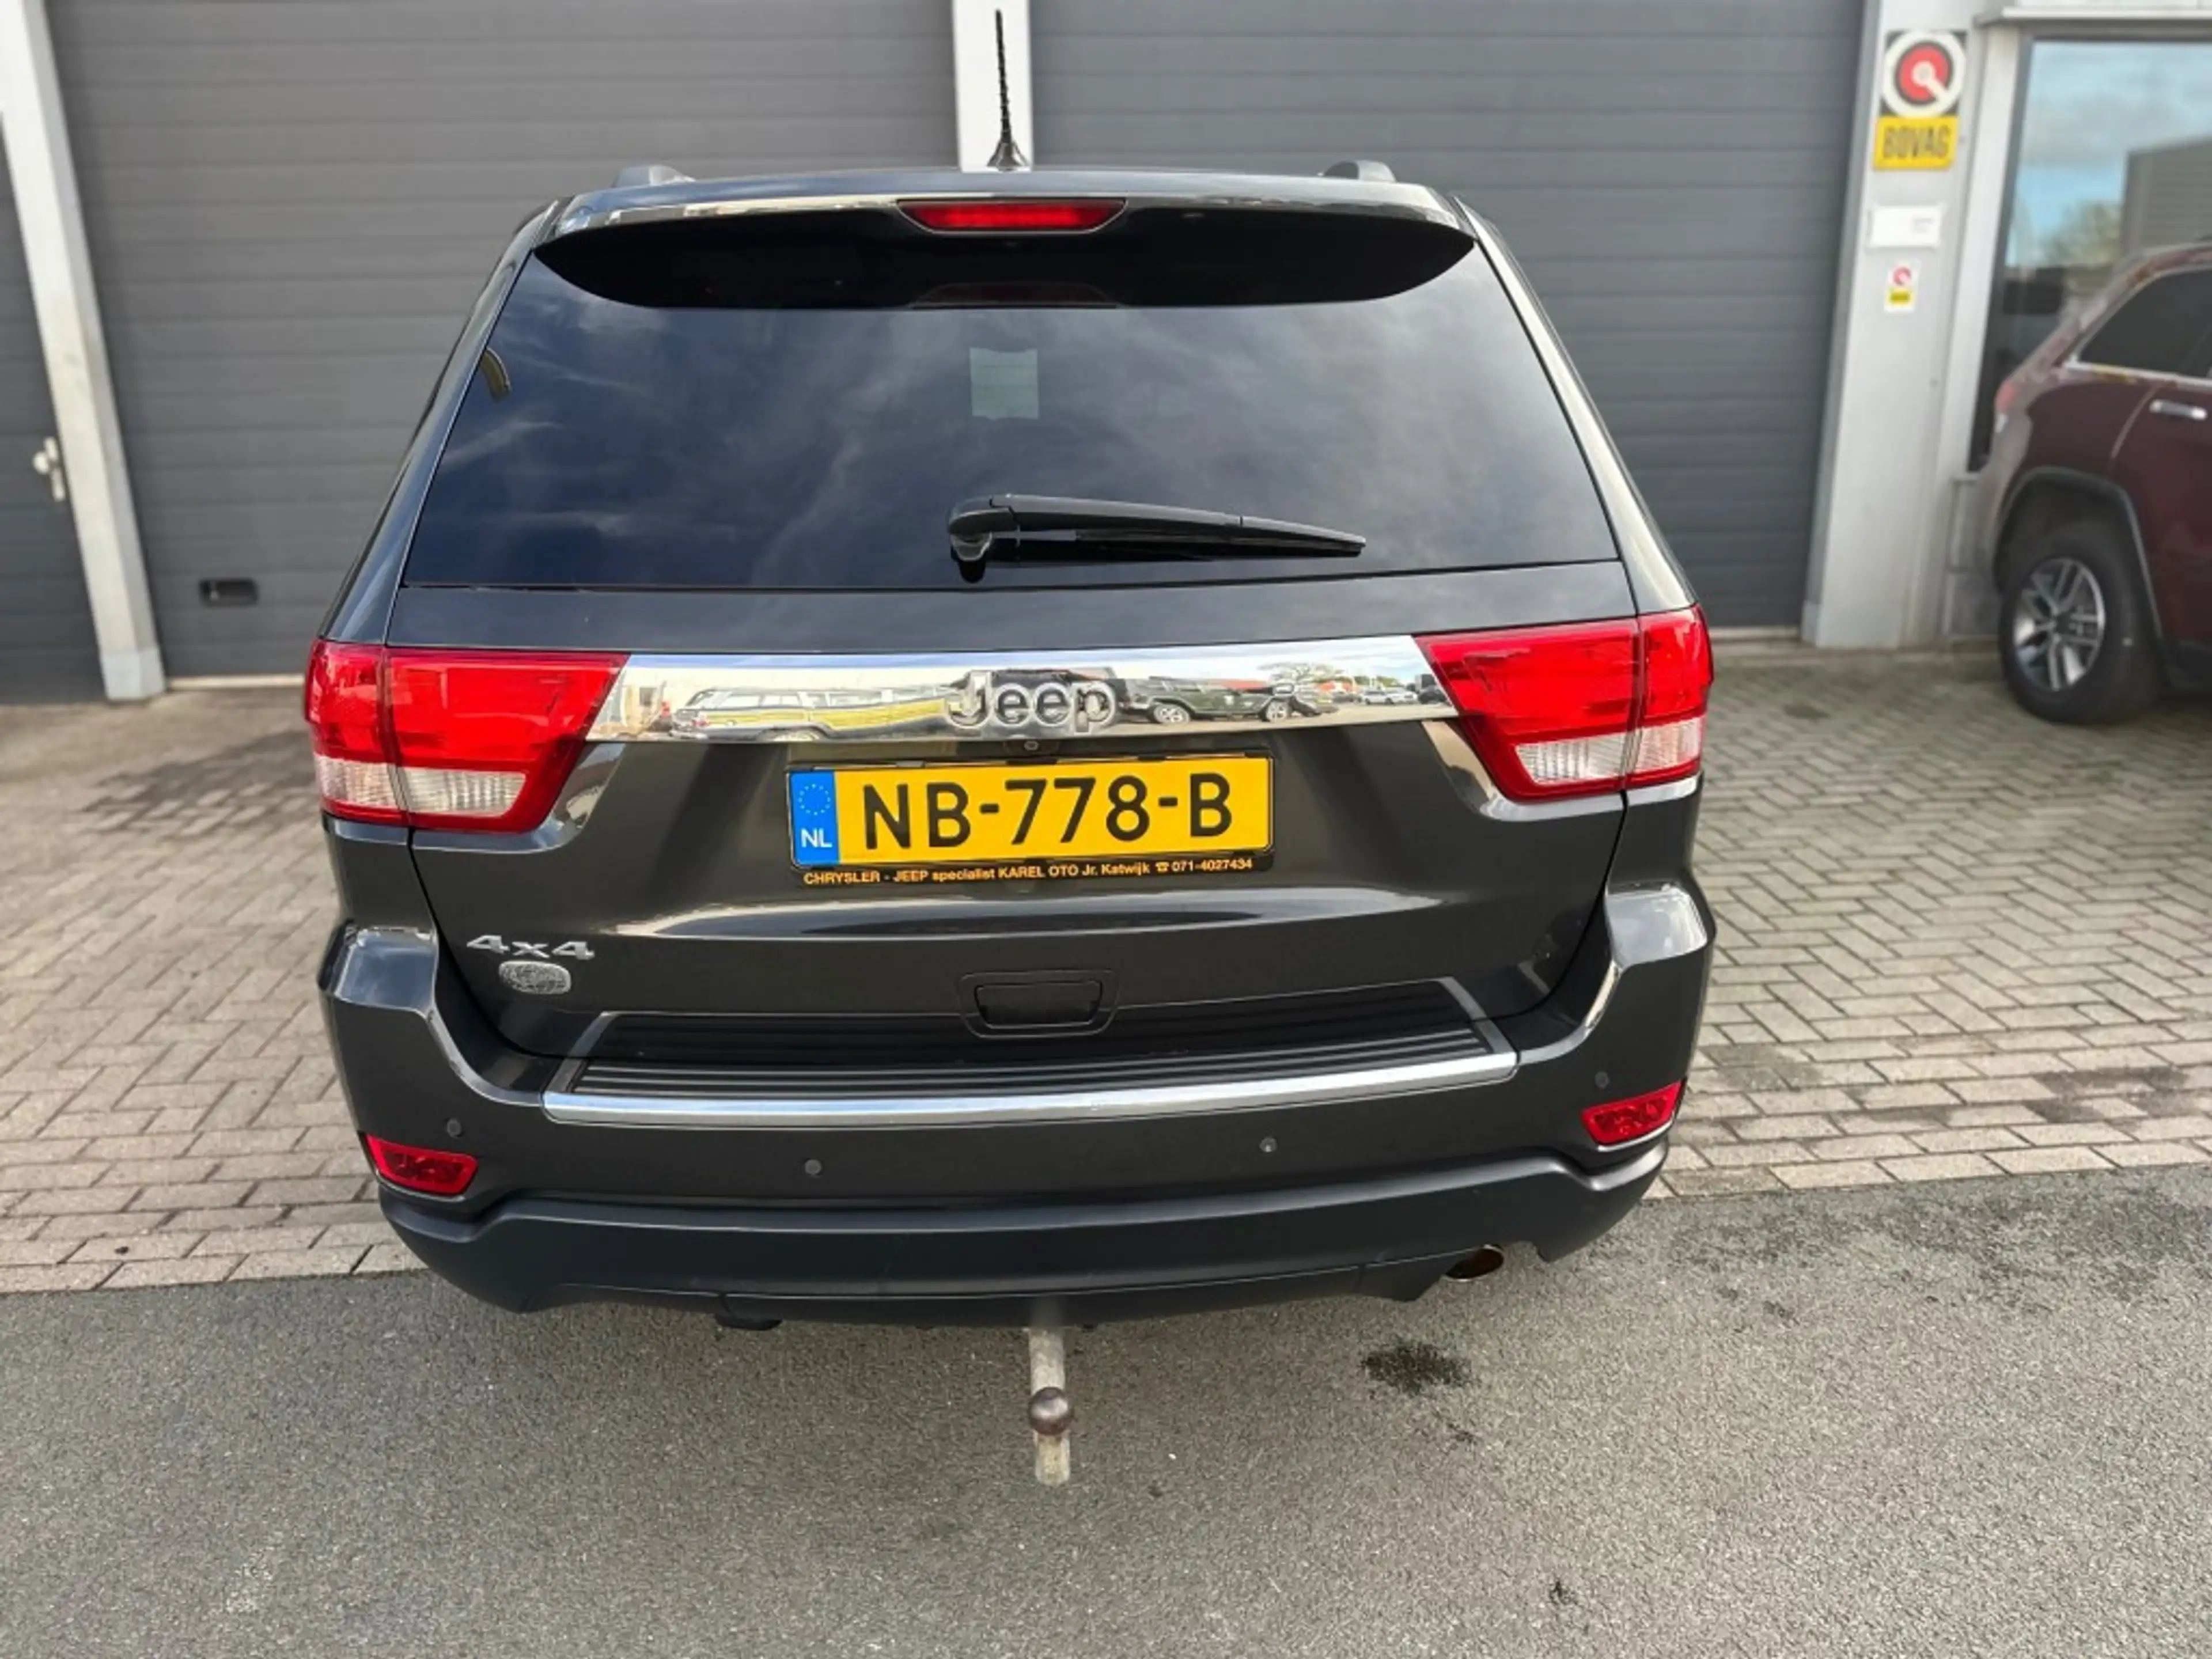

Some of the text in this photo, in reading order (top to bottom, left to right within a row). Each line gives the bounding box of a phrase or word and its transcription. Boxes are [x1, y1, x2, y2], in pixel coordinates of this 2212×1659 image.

[945, 669, 1116, 736] Jeep
[862, 772, 1232, 850] NB-778-B
[801, 828, 833, 849] NL
[804, 870, 880, 885] CHRYSLER
[893, 870, 929, 883] JEEP
[932, 867, 995, 882] specialist
[998, 865, 1046, 879] KAREL
[1048, 865, 1079, 877] OTO
[1082, 865, 1099, 876] Jr.
[1101, 861, 1150, 877] Katwijk
[1171, 858, 1253, 872] 071-4027434
[466, 934, 595, 960] 4x4
